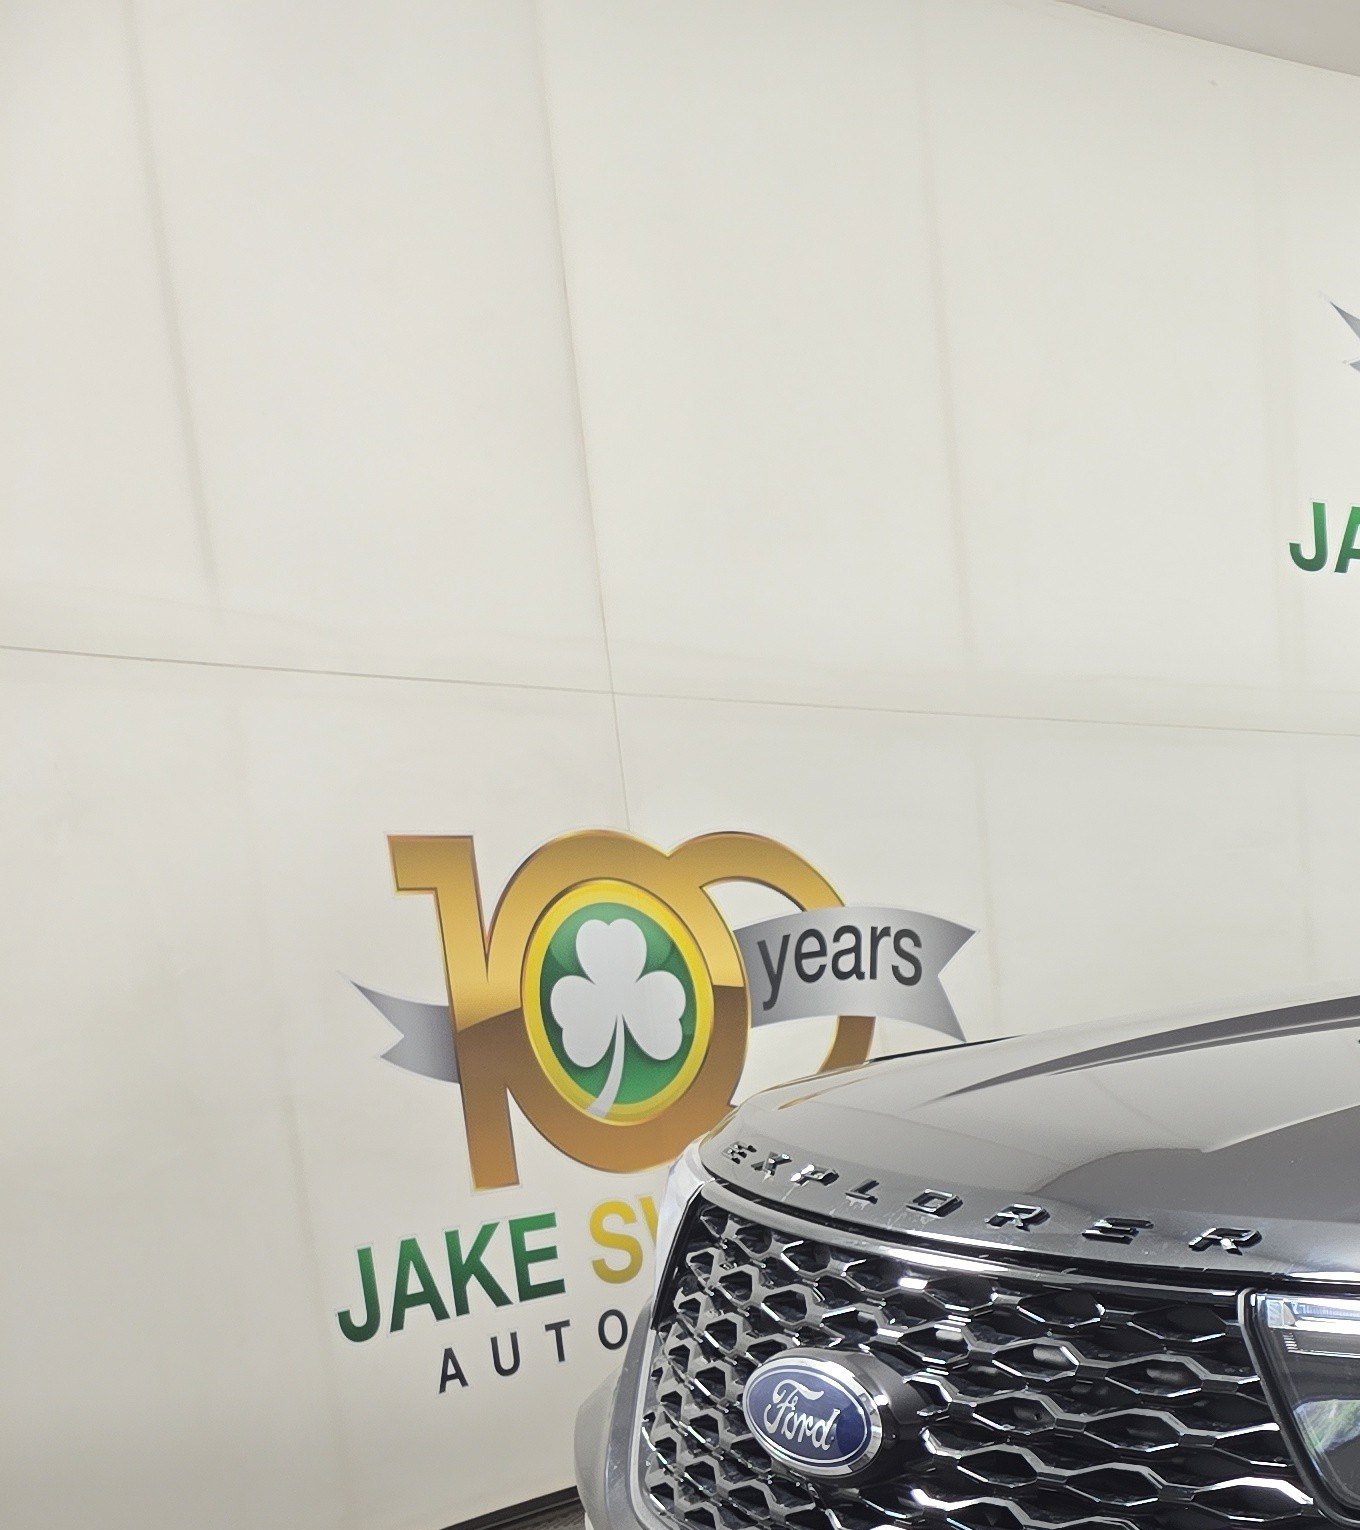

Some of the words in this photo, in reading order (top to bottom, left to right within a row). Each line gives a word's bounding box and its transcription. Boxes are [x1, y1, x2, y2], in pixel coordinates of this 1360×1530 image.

[757, 923, 923, 1011] years
[720, 1141, 1263, 1256] EXPLORER
[336, 1211, 567, 1343] JAKE
[763, 1379, 841, 1451] Ford
